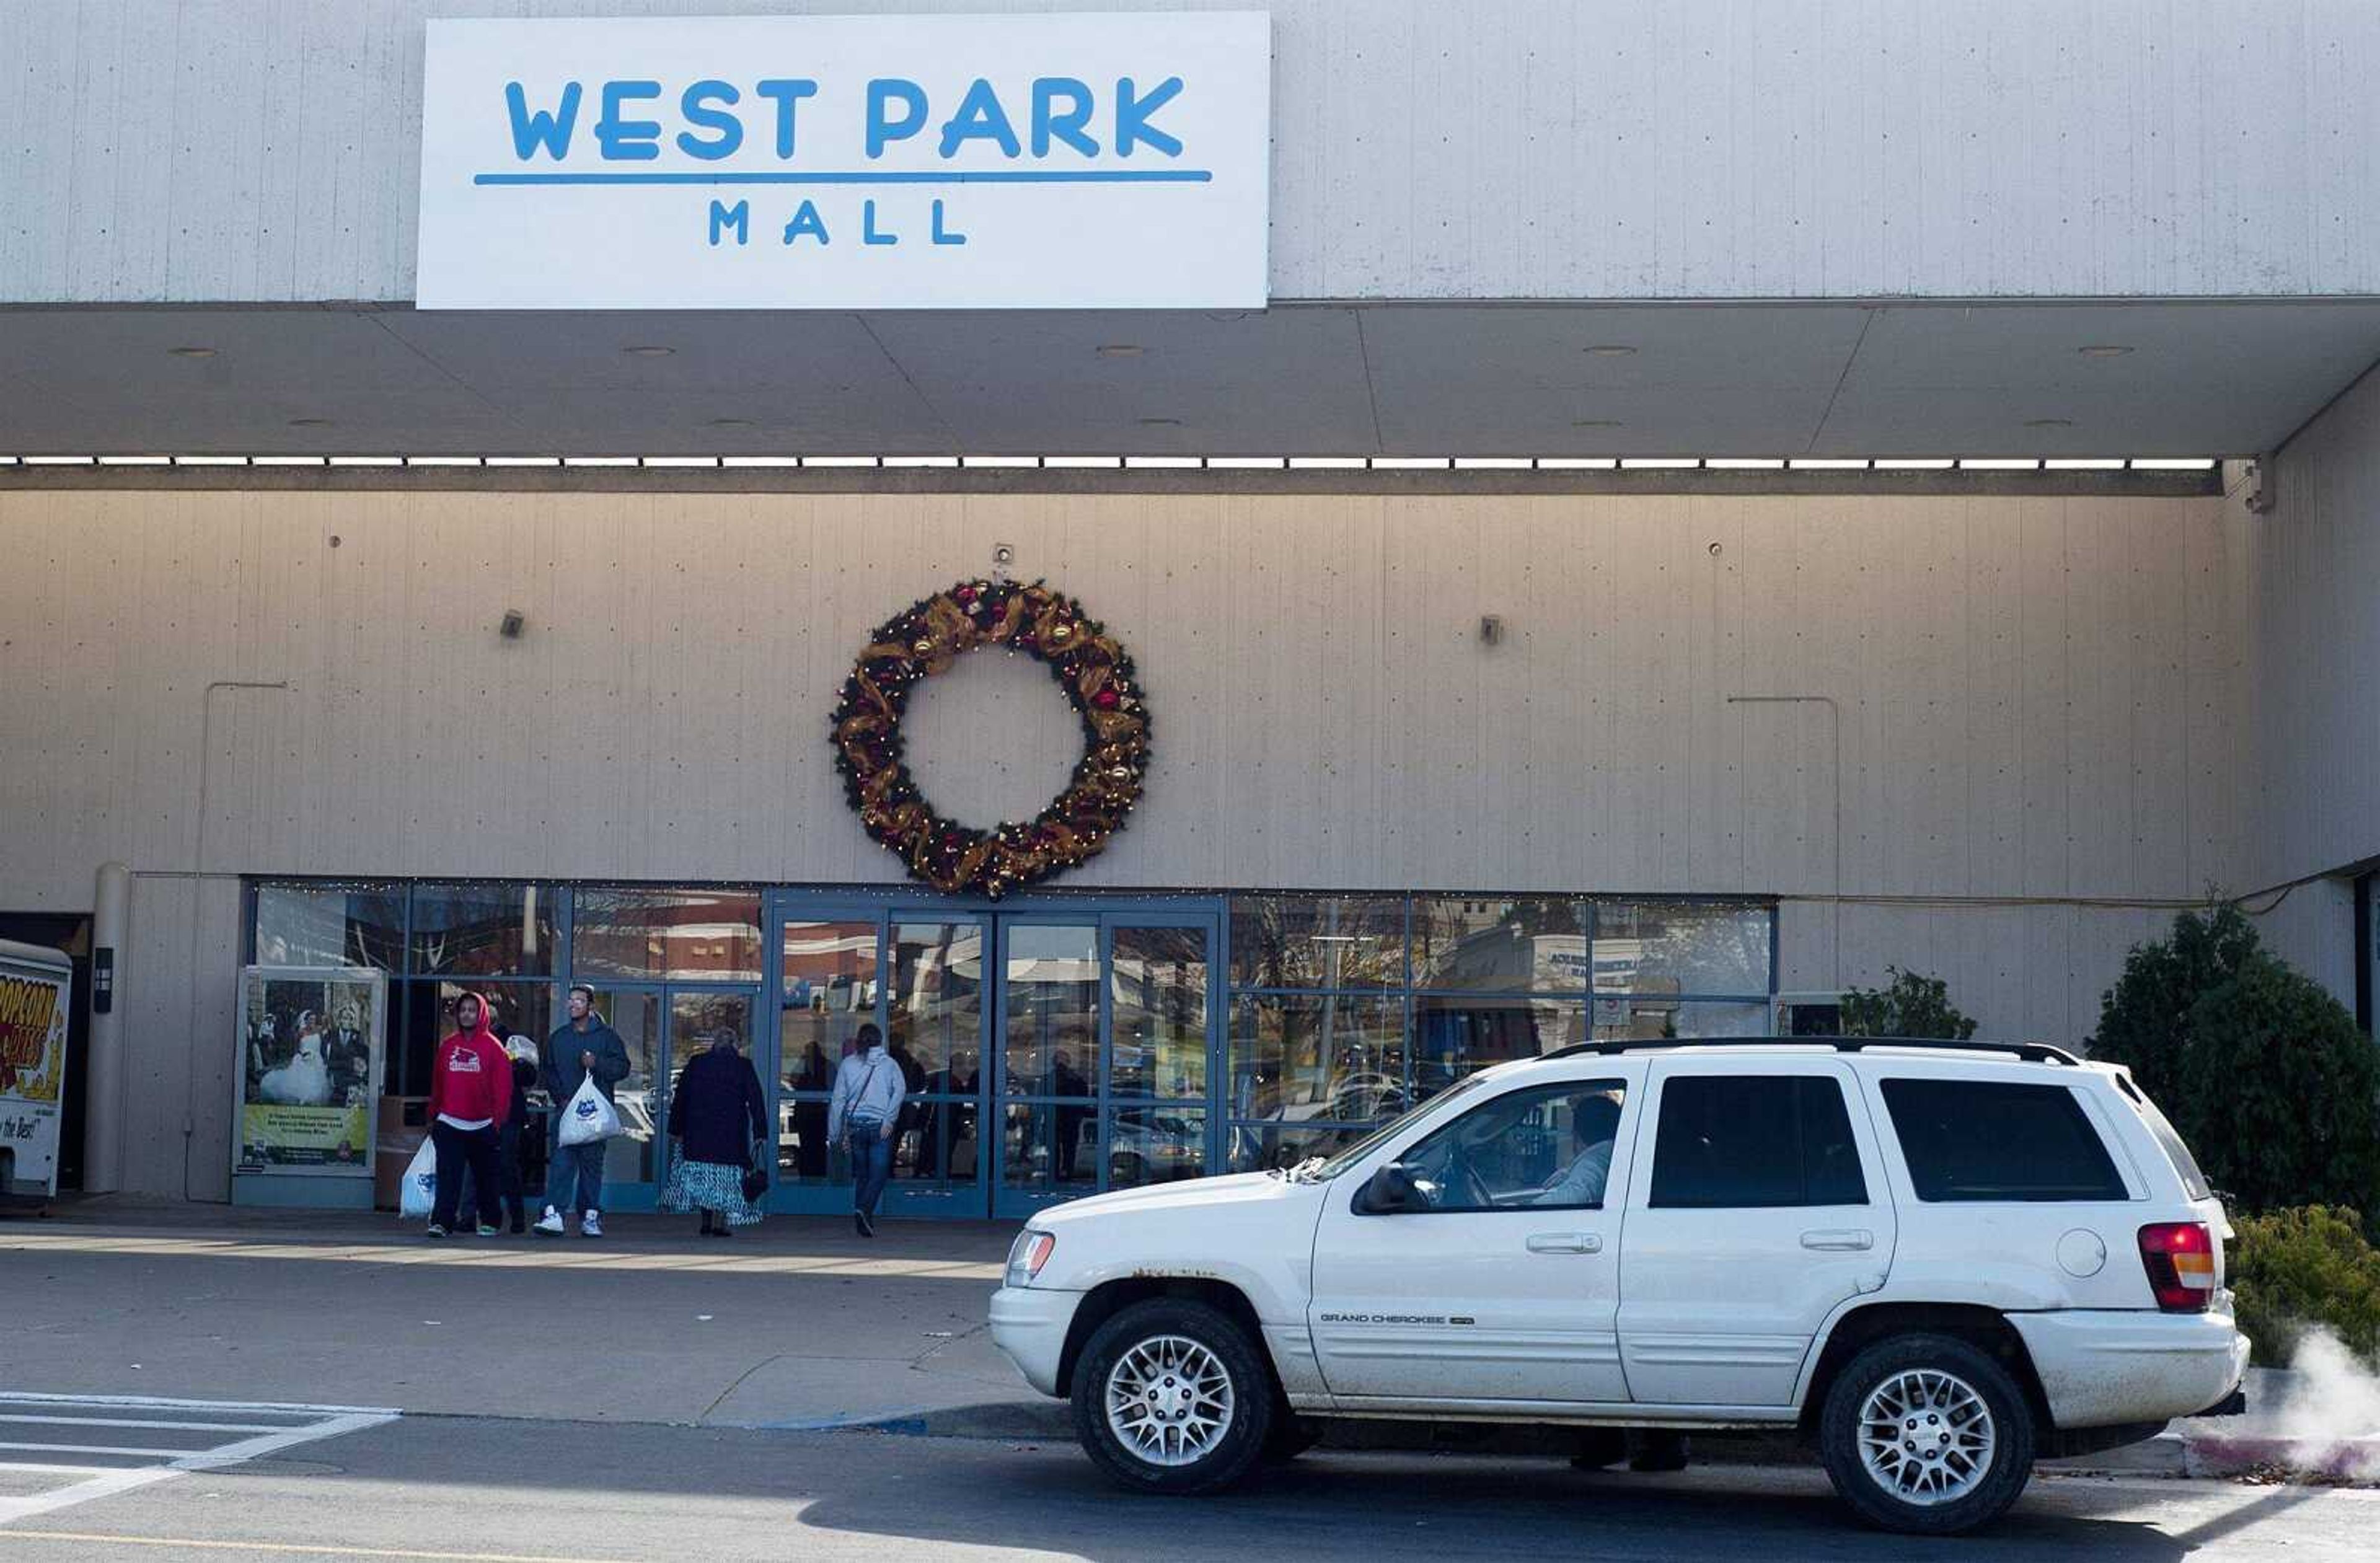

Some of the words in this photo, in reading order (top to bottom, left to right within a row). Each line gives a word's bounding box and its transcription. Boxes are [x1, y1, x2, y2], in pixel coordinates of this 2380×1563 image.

[505, 77, 819, 162] WEST
[863, 76, 1184, 159] PARK
[708, 198, 967, 247] MALL
[1321, 1313, 1368, 1322] GRAND
[1372, 1315, 1445, 1324] CHEROKEE
